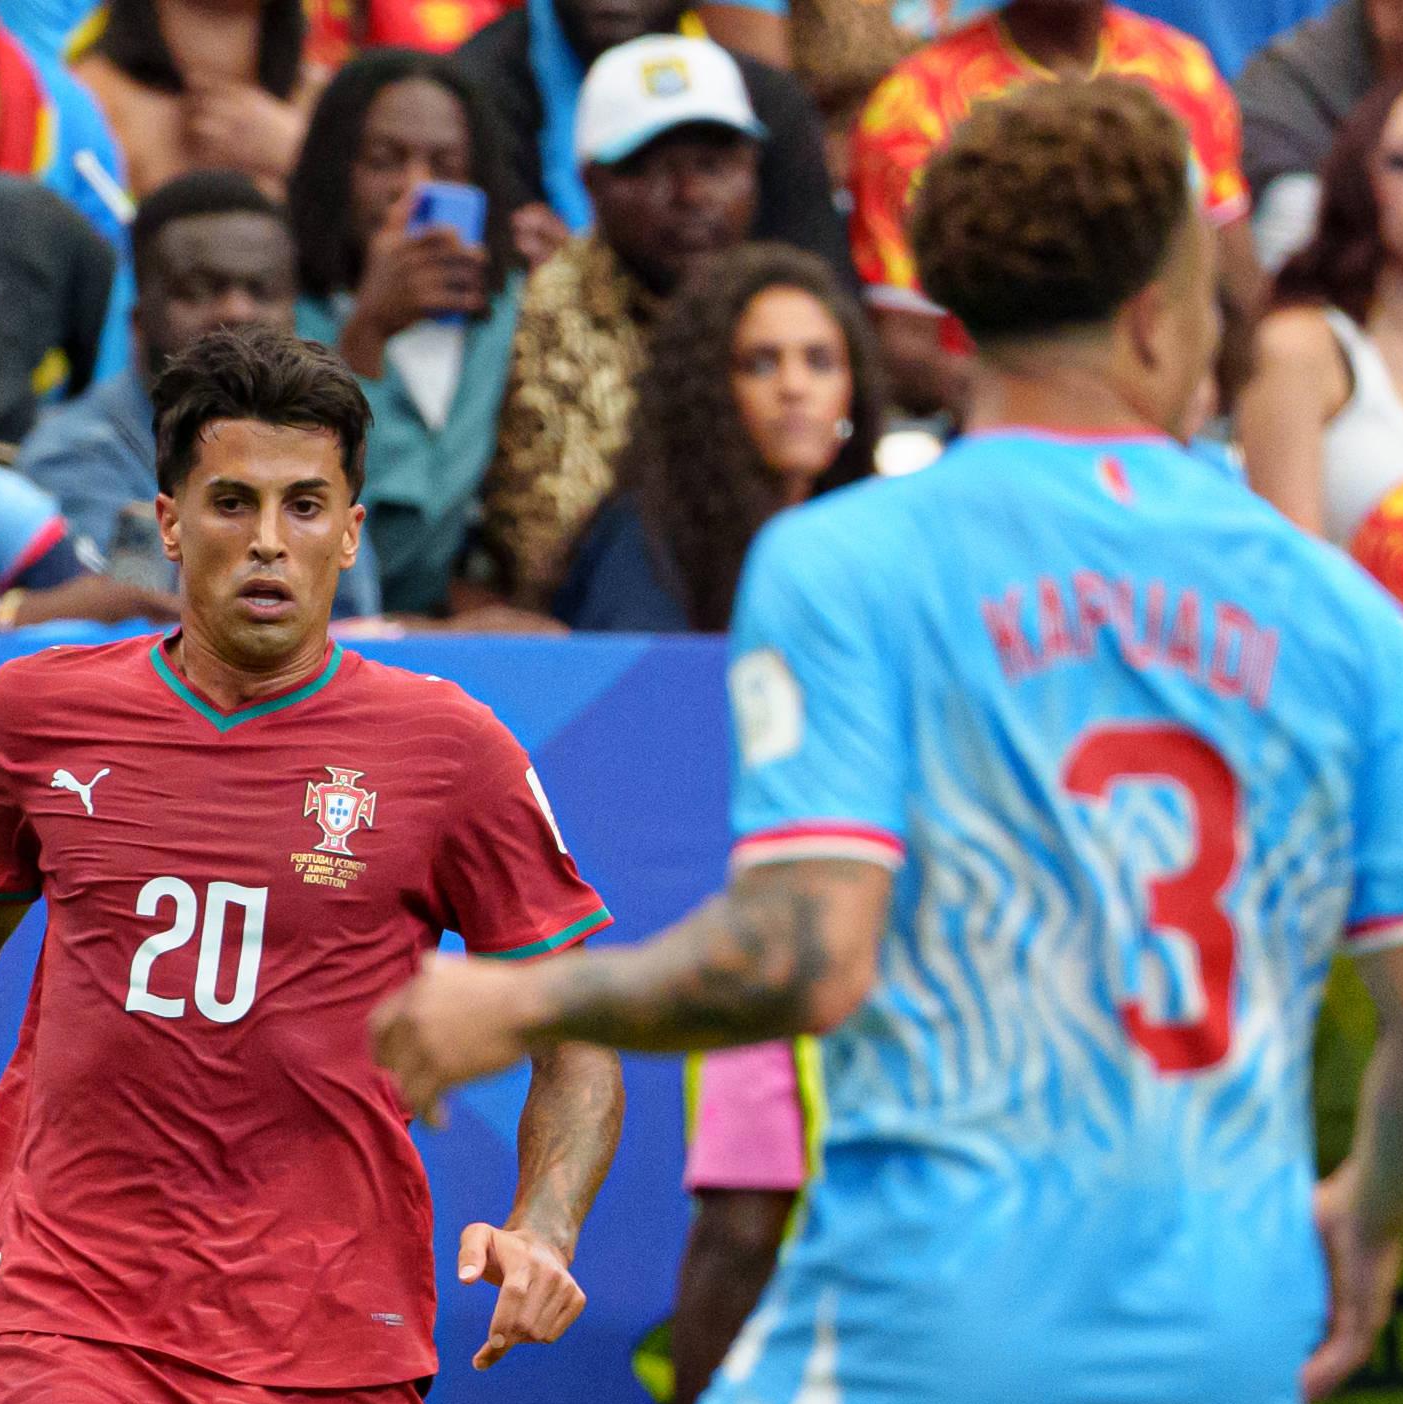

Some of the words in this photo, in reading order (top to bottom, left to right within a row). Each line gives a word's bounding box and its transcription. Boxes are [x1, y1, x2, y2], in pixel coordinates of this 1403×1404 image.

[295, 863, 305, 873] 17
[305, 864, 334, 876] JUNHO
[303, 873, 347, 889] HOUSTON
[1058, 720, 1244, 1076] 3
[125, 876, 269, 1024] 20
